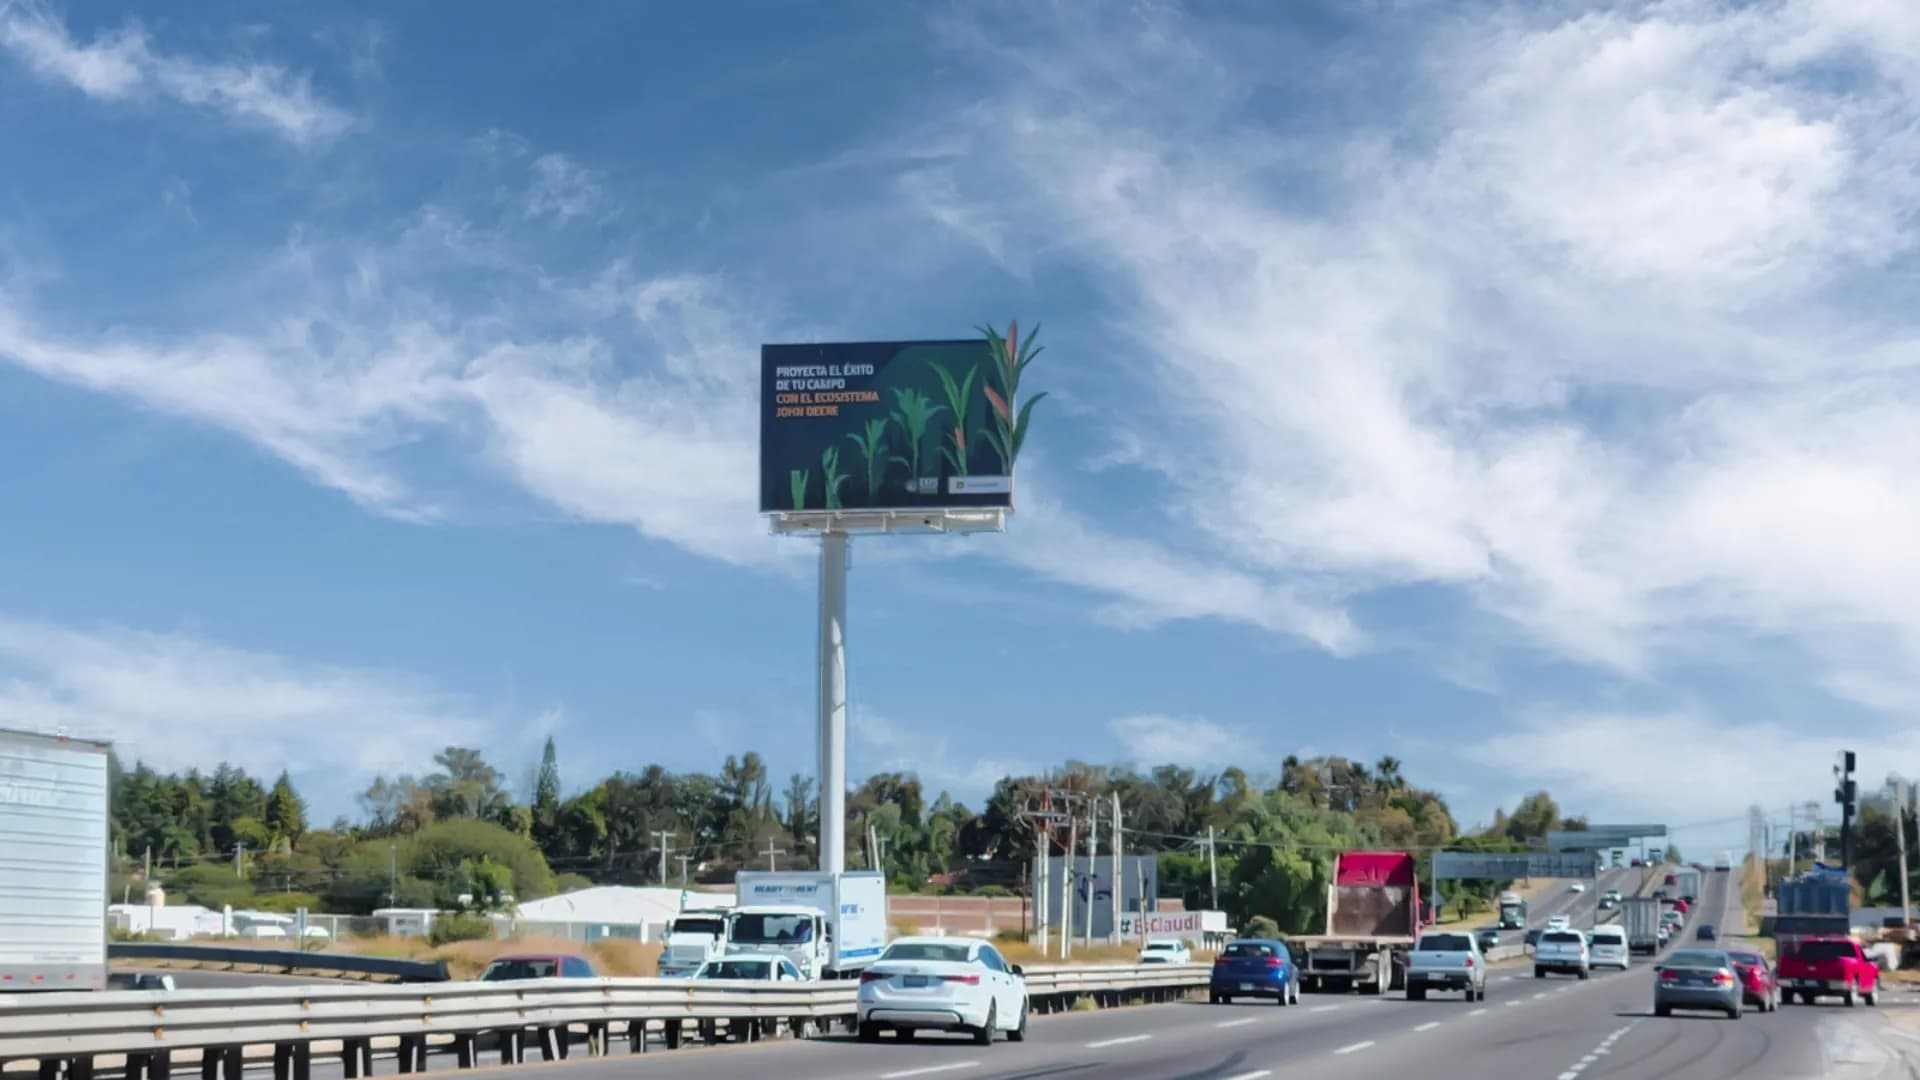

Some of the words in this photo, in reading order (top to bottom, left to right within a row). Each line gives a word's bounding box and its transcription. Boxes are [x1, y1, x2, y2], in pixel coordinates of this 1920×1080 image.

[776, 366, 828, 377] PROYECTA
[829, 365, 842, 376] EL
[843, 362, 874, 376] ÉXITO
[776, 380, 791, 391] DE
[792, 379, 806, 390] TU
[807, 378, 846, 390] CAMPO
[776, 393, 799, 404] CON
[800, 393, 813, 403] EL
[815, 391, 880, 403] ECOSISTEMA
[776, 406, 805, 417] JOHN
[806, 405, 839, 416] DEERE
